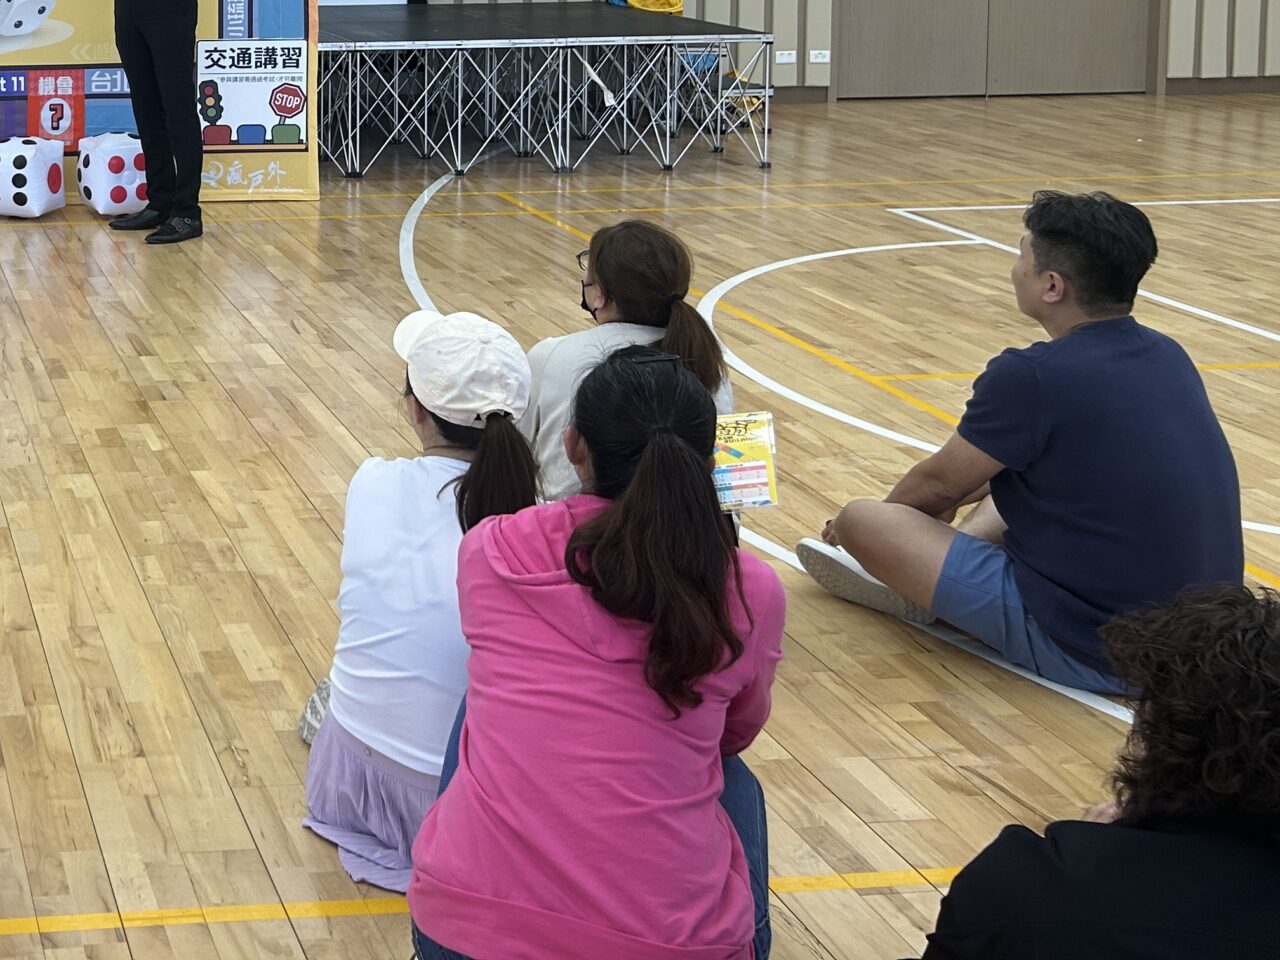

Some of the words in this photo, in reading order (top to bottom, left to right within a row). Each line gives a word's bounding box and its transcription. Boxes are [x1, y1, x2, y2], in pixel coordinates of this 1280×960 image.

[204, 46, 302, 69] 交通講習
[11, 76, 25, 91] 11
[38, 76, 74, 95] 機會
[275, 92, 301, 109] STOP
